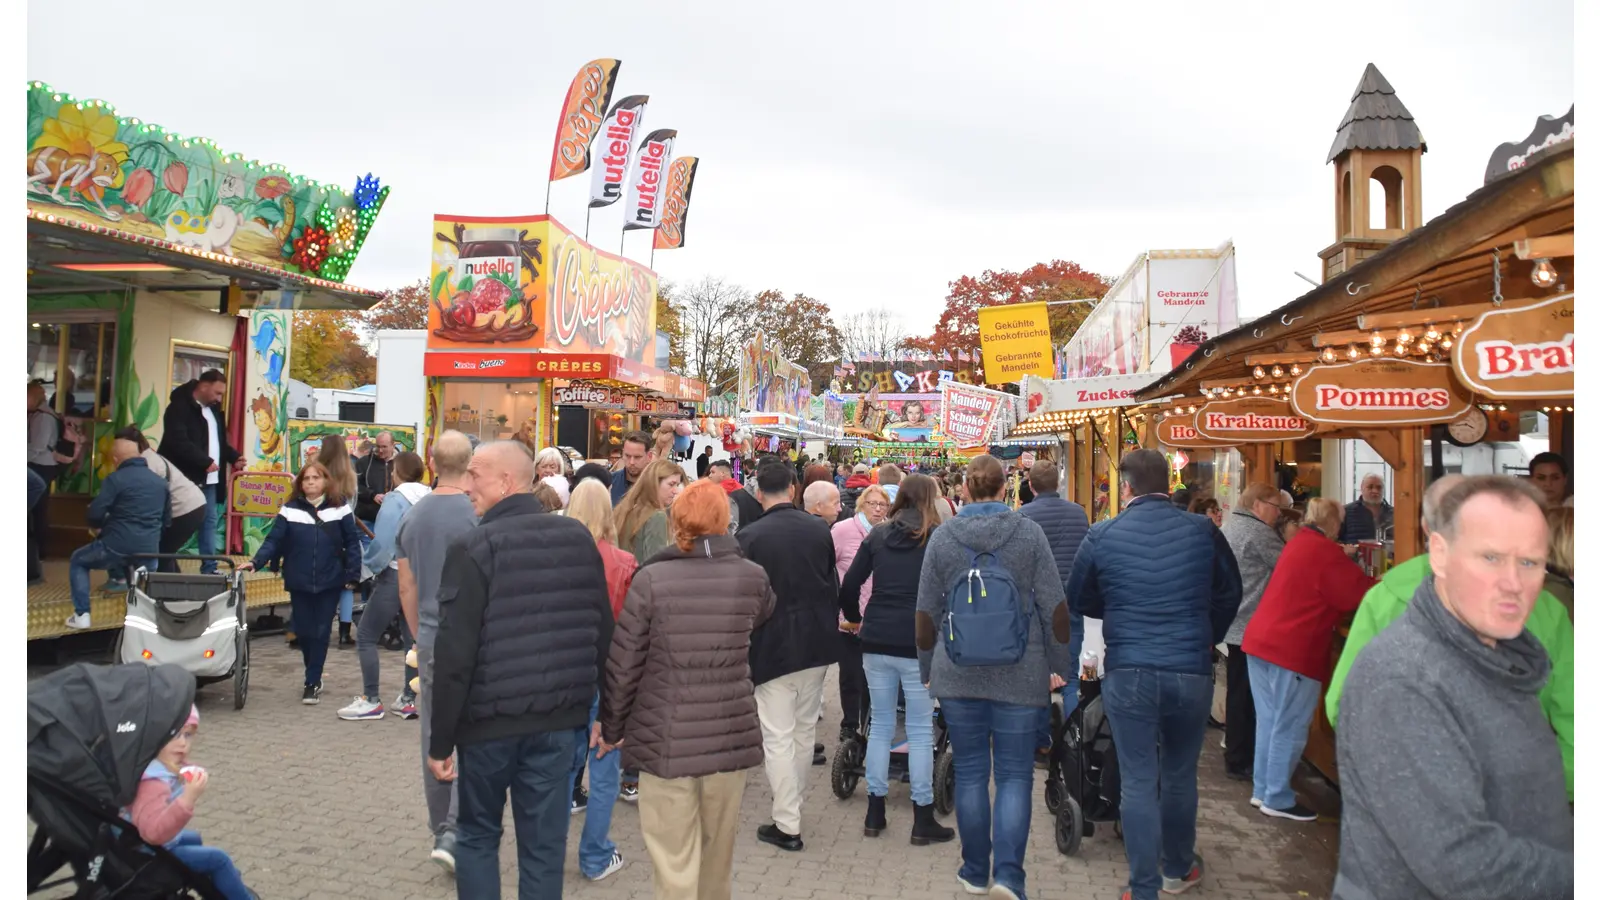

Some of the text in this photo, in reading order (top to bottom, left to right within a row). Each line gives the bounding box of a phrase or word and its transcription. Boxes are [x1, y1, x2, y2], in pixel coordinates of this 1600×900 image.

[557, 64, 605, 170] Crêpes
[603, 109, 636, 198] nutella
[636, 140, 667, 223] nutella
[465, 258, 515, 275] nutella
[554, 234, 634, 345] Crêpes
[1157, 290, 1209, 298] Gebrannte
[994, 319, 1035, 331] Gekühlte
[983, 328, 1049, 343] Schokofrüchte
[479, 358, 507, 370] bueno
[536, 358, 602, 372] CRÊPES
[995, 350, 1043, 363] Gebrannte
[1001, 361, 1040, 373] Mandeln
[858, 369, 974, 393] SHAKER
[556, 386, 605, 404] Toffifee
[950, 391, 993, 411] Mandeln
[1320, 387, 1449, 408] Pommes
[1207, 413, 1307, 430] Krakauer
[1172, 426, 1196, 438] Ho
[264, 482, 285, 493] Maja
[116, 721, 137, 733] Joie
[86, 855, 104, 883] Joie
